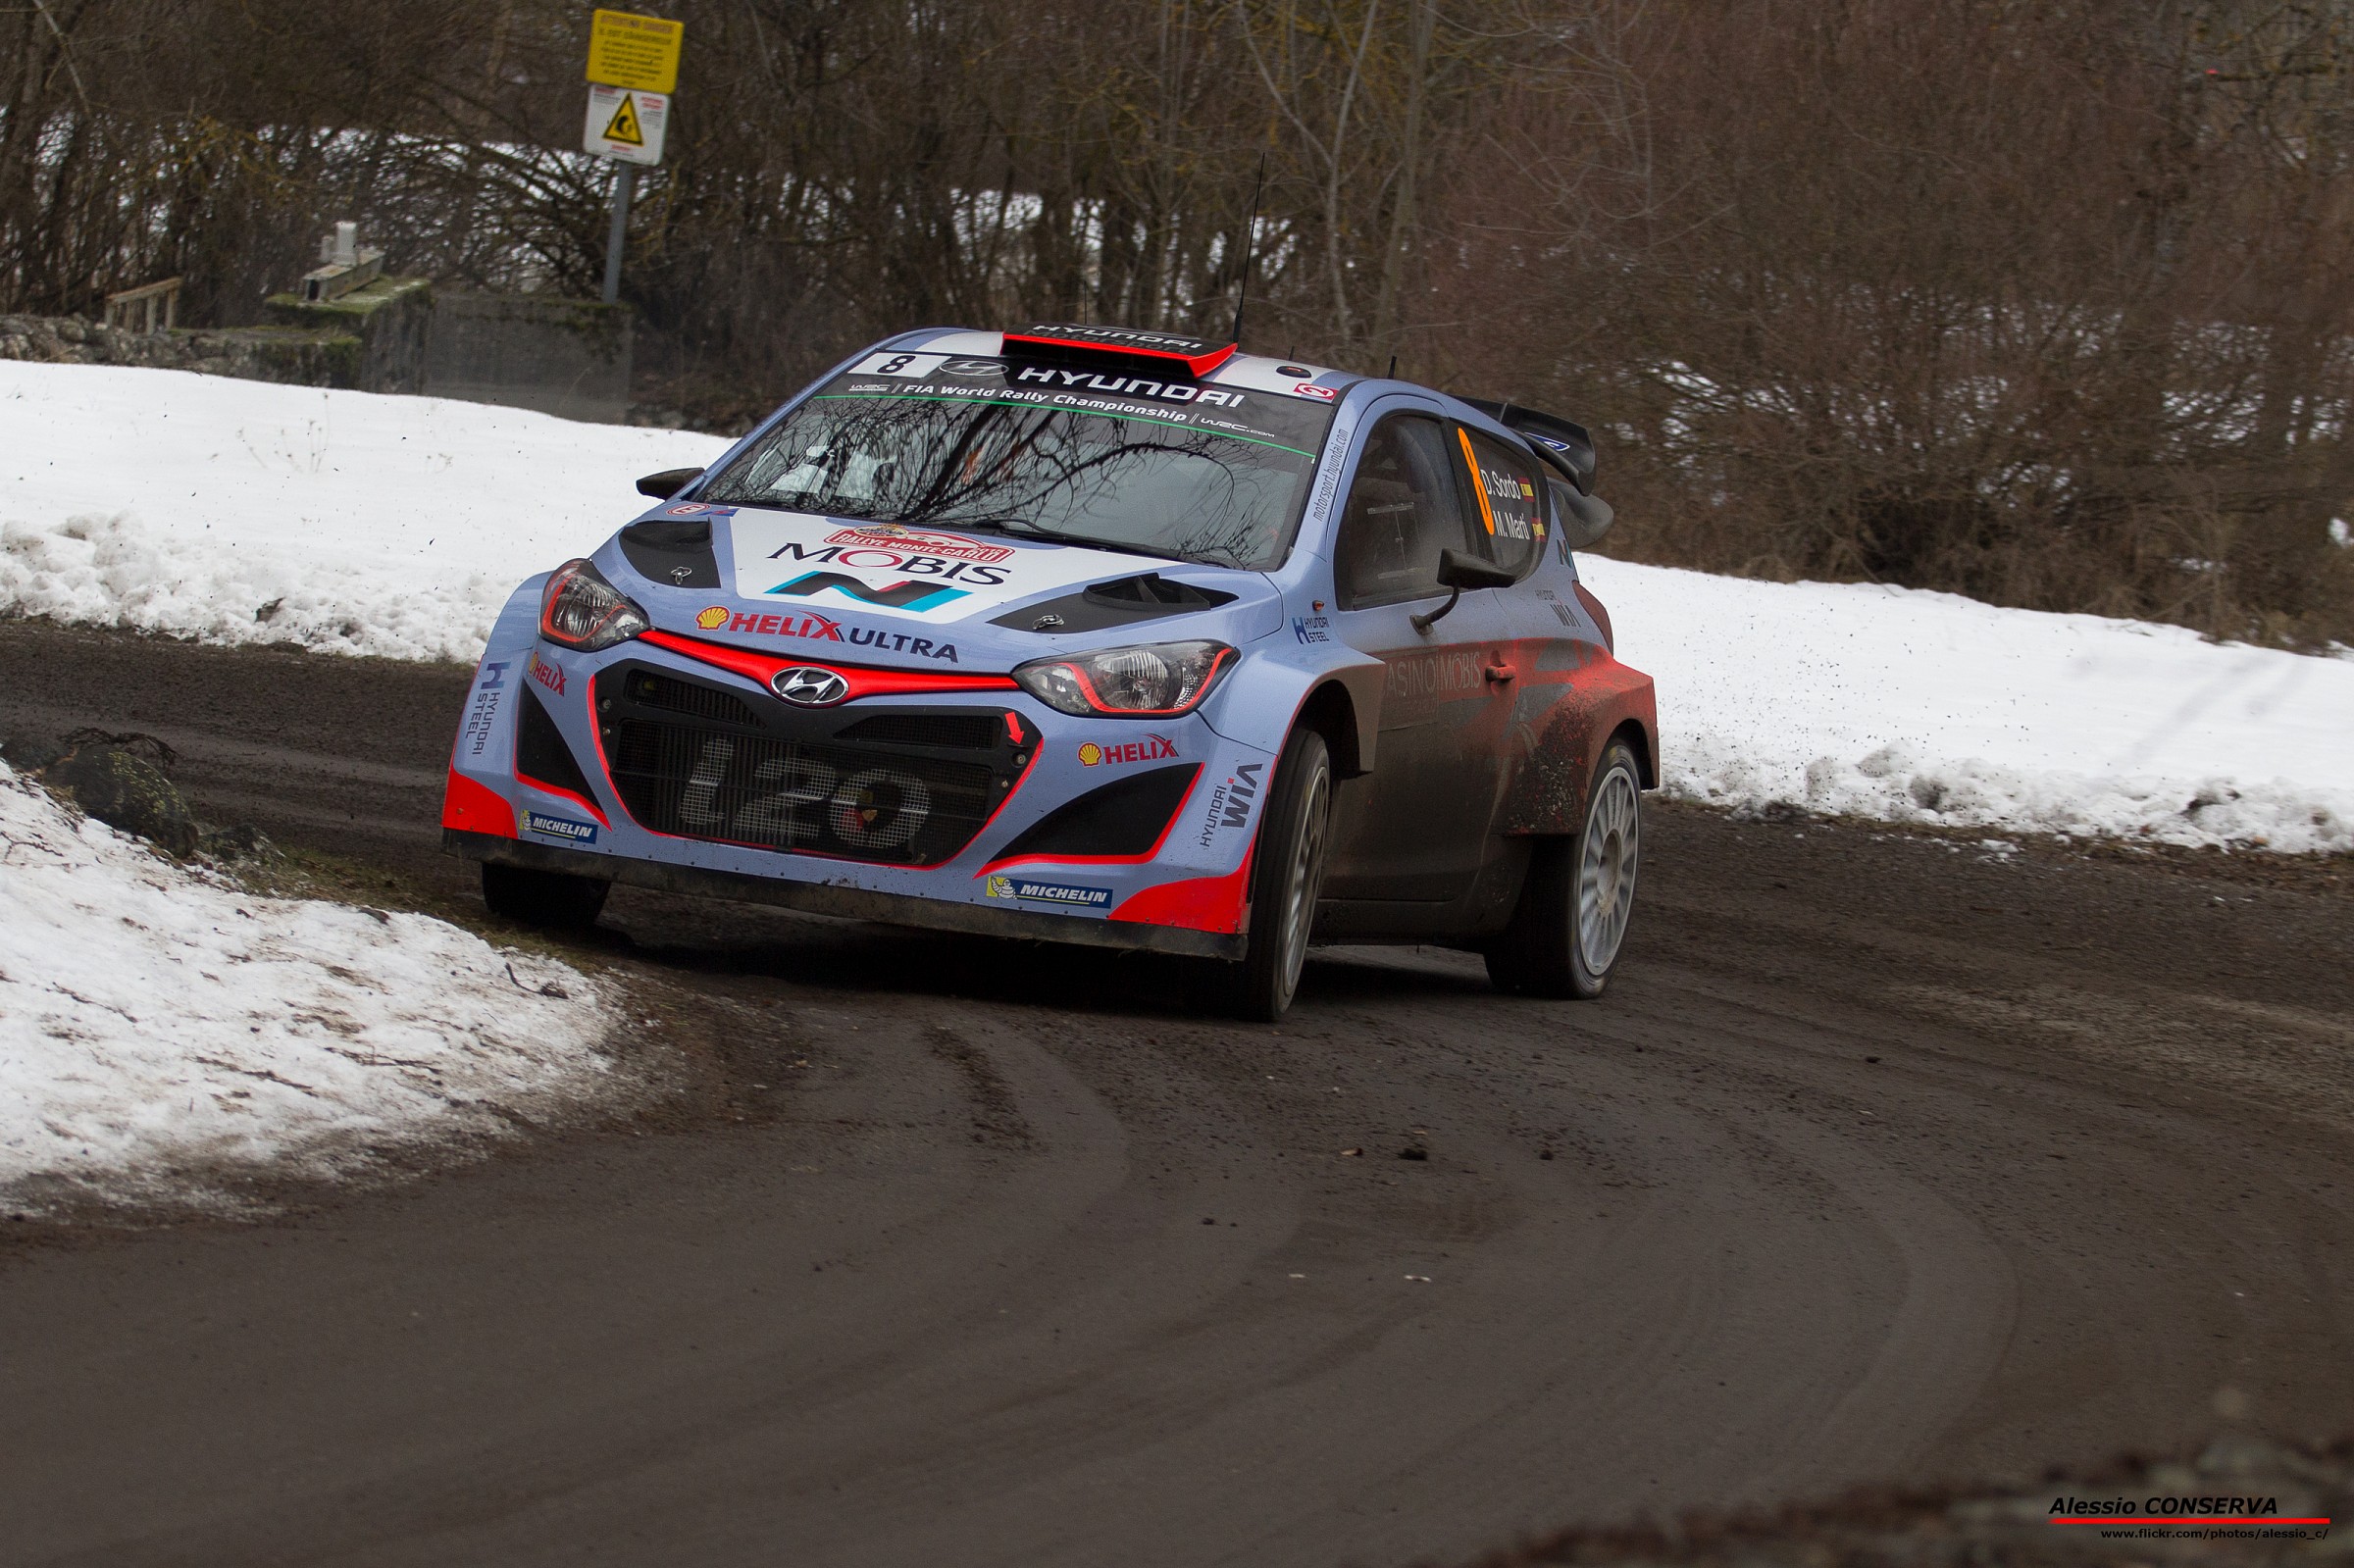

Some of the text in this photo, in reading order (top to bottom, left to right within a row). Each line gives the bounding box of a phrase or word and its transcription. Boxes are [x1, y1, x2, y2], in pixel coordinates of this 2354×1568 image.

[1033, 325, 1203, 348] HYUNDAI
[877, 355, 916, 375] 8
[902, 384, 933, 394] FIA
[941, 385, 995, 398] World
[998, 389, 1049, 403] Rally
[1053, 394, 1187, 423] Championship
[1017, 367, 1245, 408] HYUNDAI
[1313, 429, 1349, 523] motorsport.hyundai.com
[1458, 427, 1495, 535] 8
[1480, 469, 1520, 500] D. Sordo
[1493, 510, 1509, 537] M.
[766, 542, 1012, 585] MOBIS
[835, 532, 1000, 561] RALLYE MONTE-CARLO
[728, 609, 959, 664] HELIX ULTRA
[1305, 617, 1329, 629] HYUNDAI
[1307, 632, 1330, 643] STEEL
[533, 660, 568, 697] HELIX
[1440, 651, 1481, 692] MOBIS
[465, 692, 487, 739] STEEL
[472, 692, 500, 755] HYUNDAI
[1102, 733, 1179, 765] HELIX
[1221, 763, 1263, 829] WIA
[533, 816, 592, 837] MICHELIN
[1200, 784, 1227, 847] HYUNDAI
[1020, 884, 1107, 903] MICHELIN
